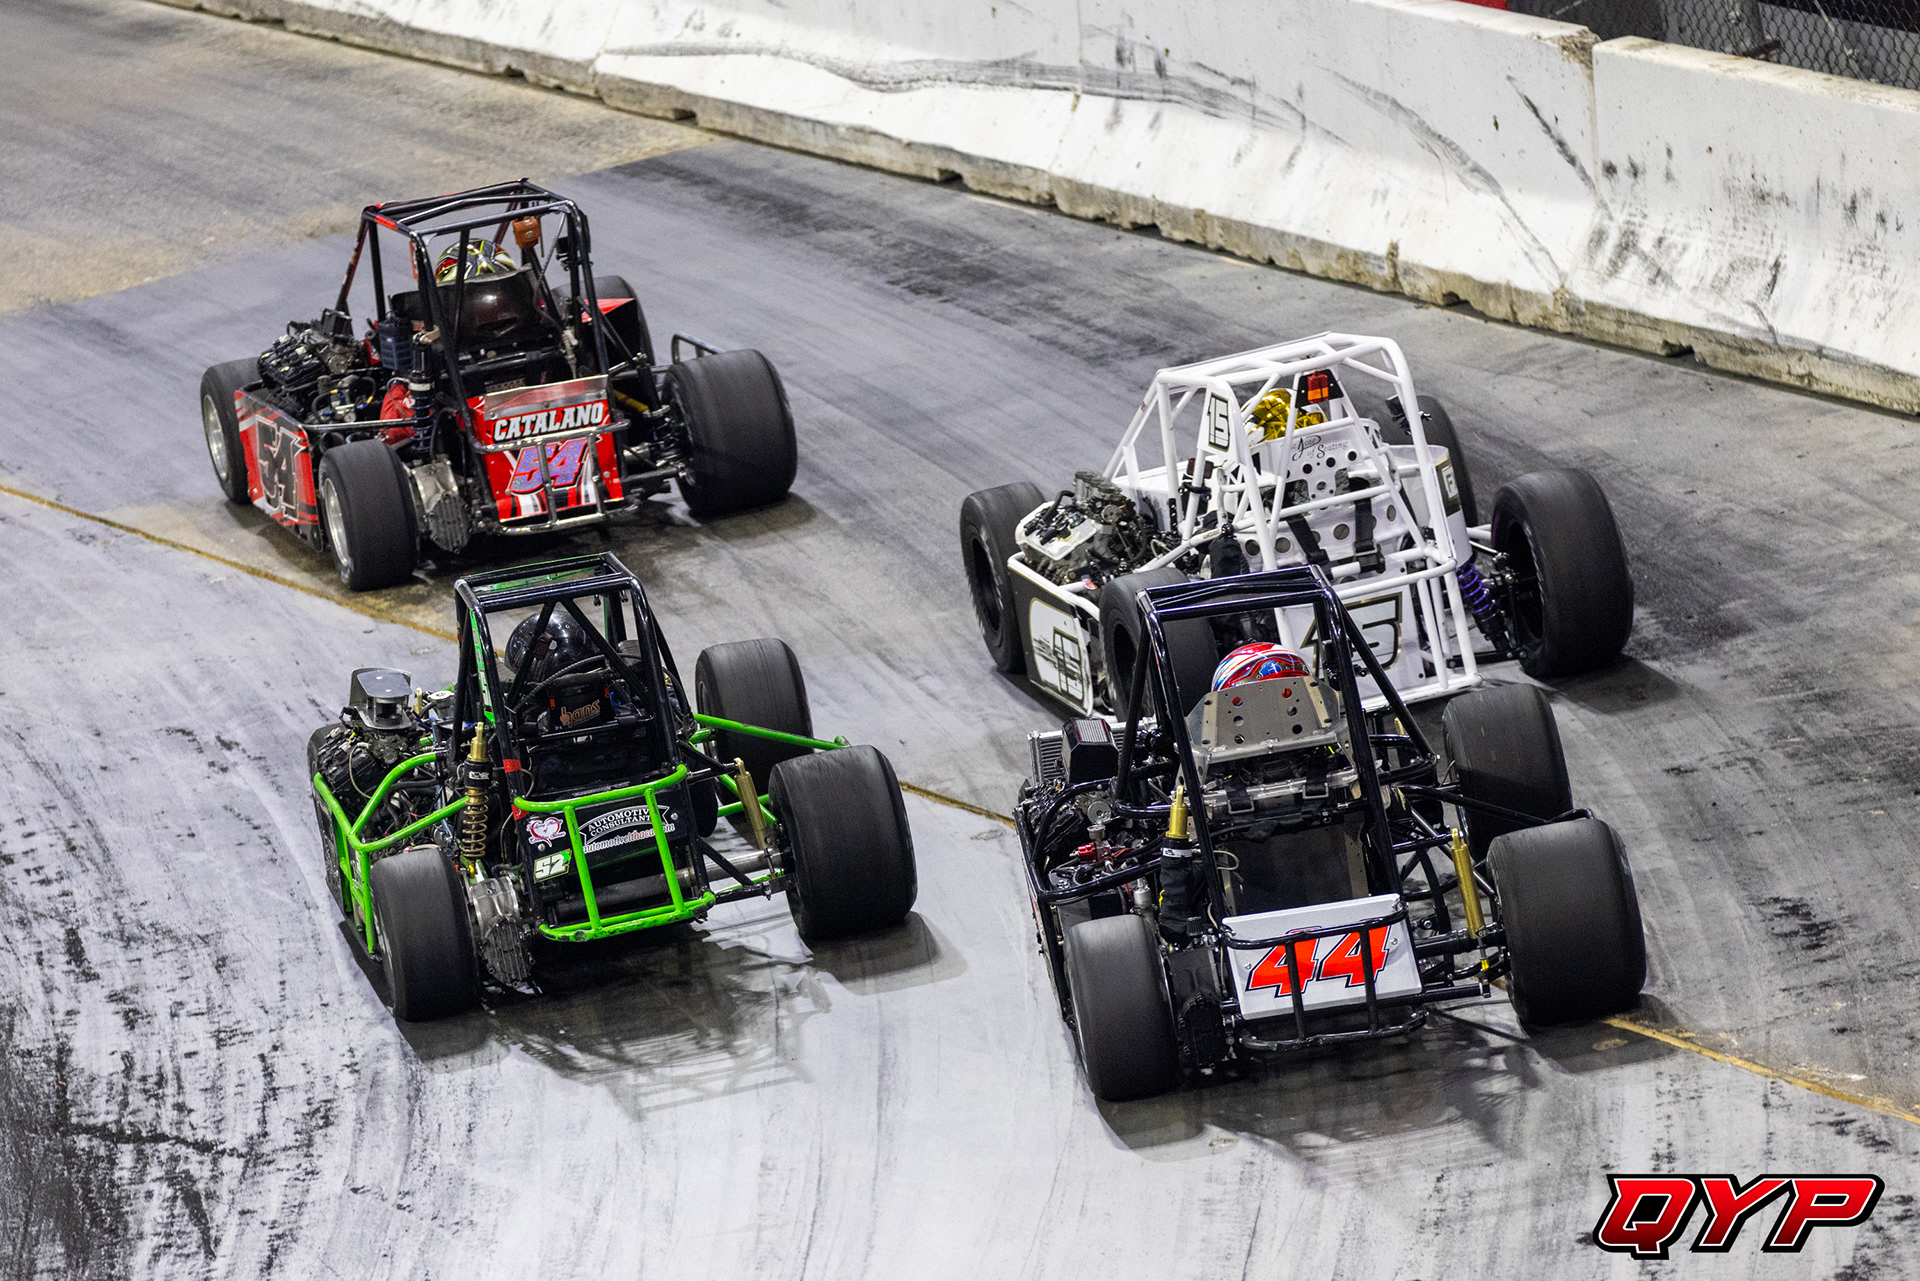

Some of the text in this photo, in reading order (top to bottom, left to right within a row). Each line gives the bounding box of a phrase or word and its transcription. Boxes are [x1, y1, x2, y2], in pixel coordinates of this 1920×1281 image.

[493, 402, 604, 442] CATALANO
[1208, 391, 1231, 452] 15
[255, 414, 306, 522] 54
[509, 437, 592, 495] 54
[588, 809, 650, 831] AUTOMOTIV
[590, 816, 652, 837] CONSULTANT
[535, 853, 570, 880] 52
[1245, 918, 1392, 998] 44
